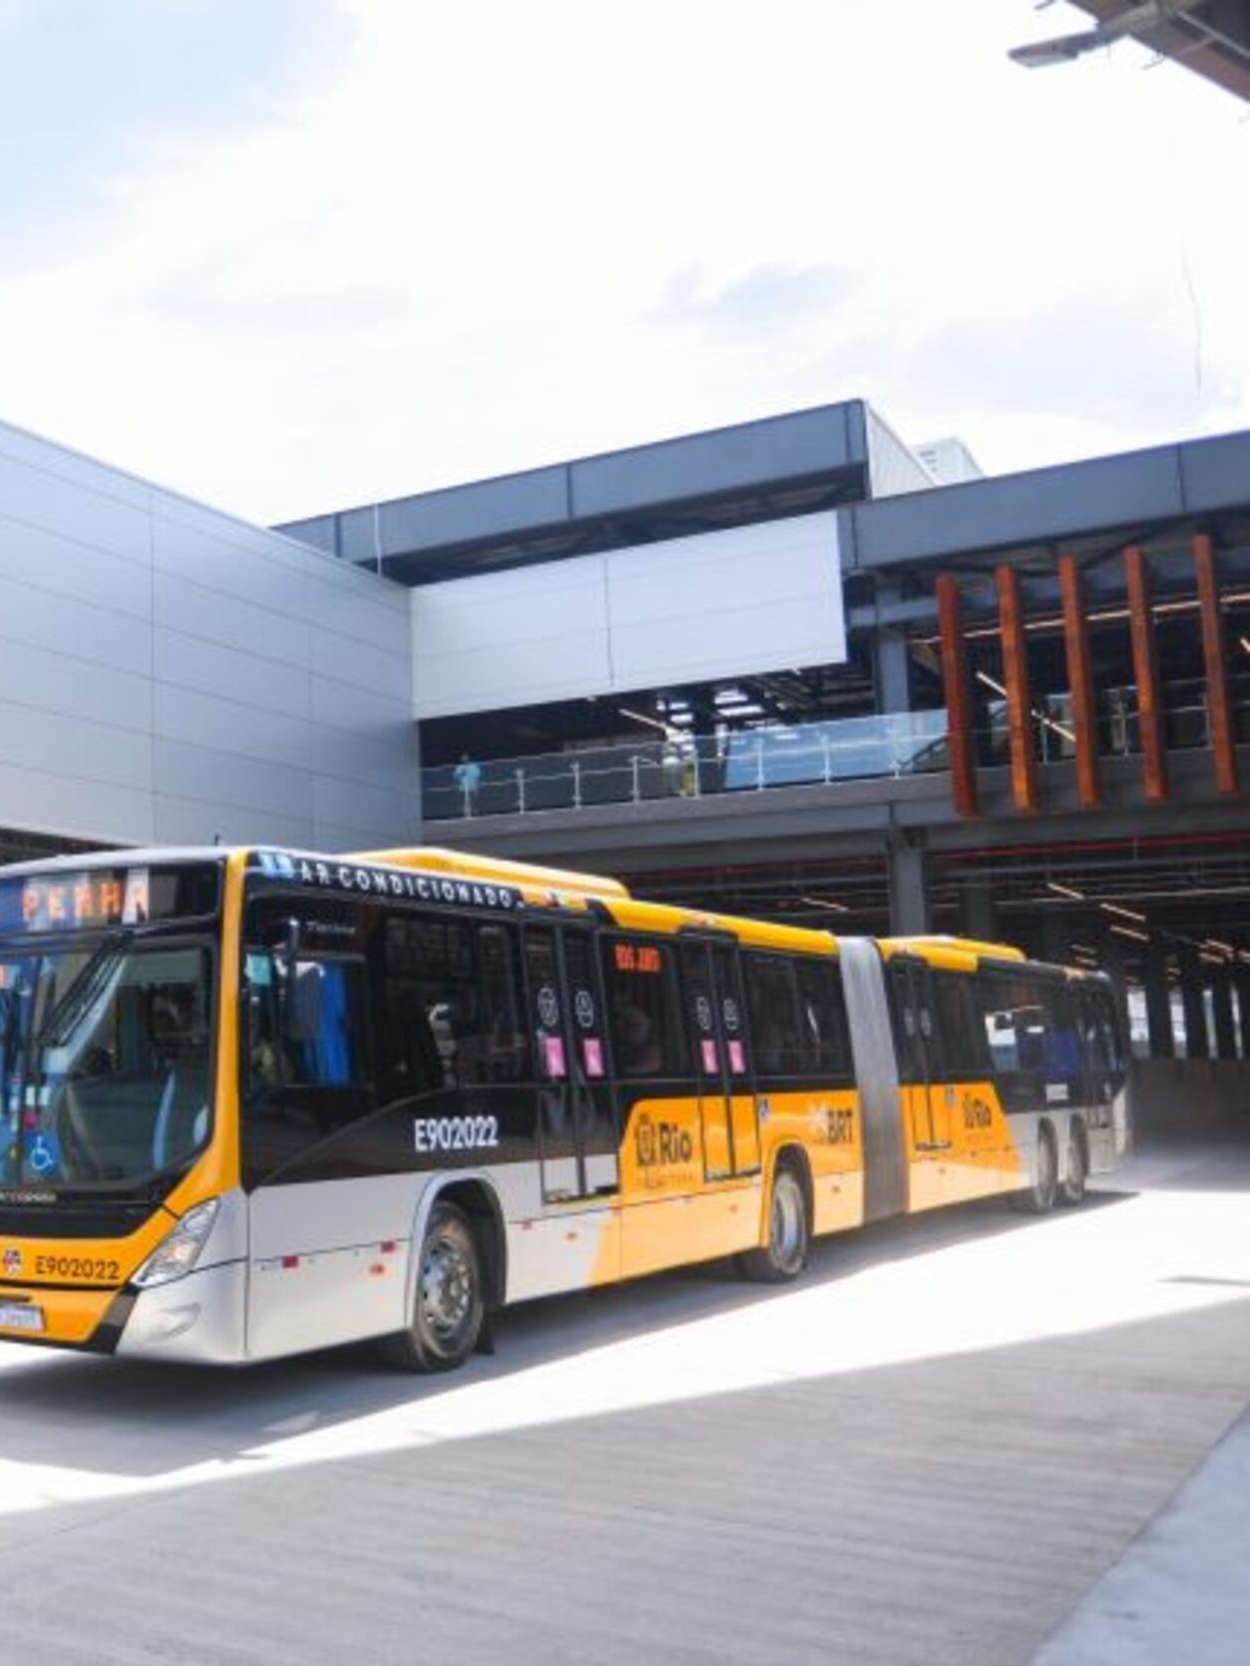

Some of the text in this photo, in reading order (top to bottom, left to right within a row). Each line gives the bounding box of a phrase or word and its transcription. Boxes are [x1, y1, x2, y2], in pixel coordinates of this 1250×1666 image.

[302, 861, 331, 885] AR
[414, 1116, 499, 1151] E902022
[658, 1122, 692, 1166] Rio
[35, 1256, 120, 1280] E902022
